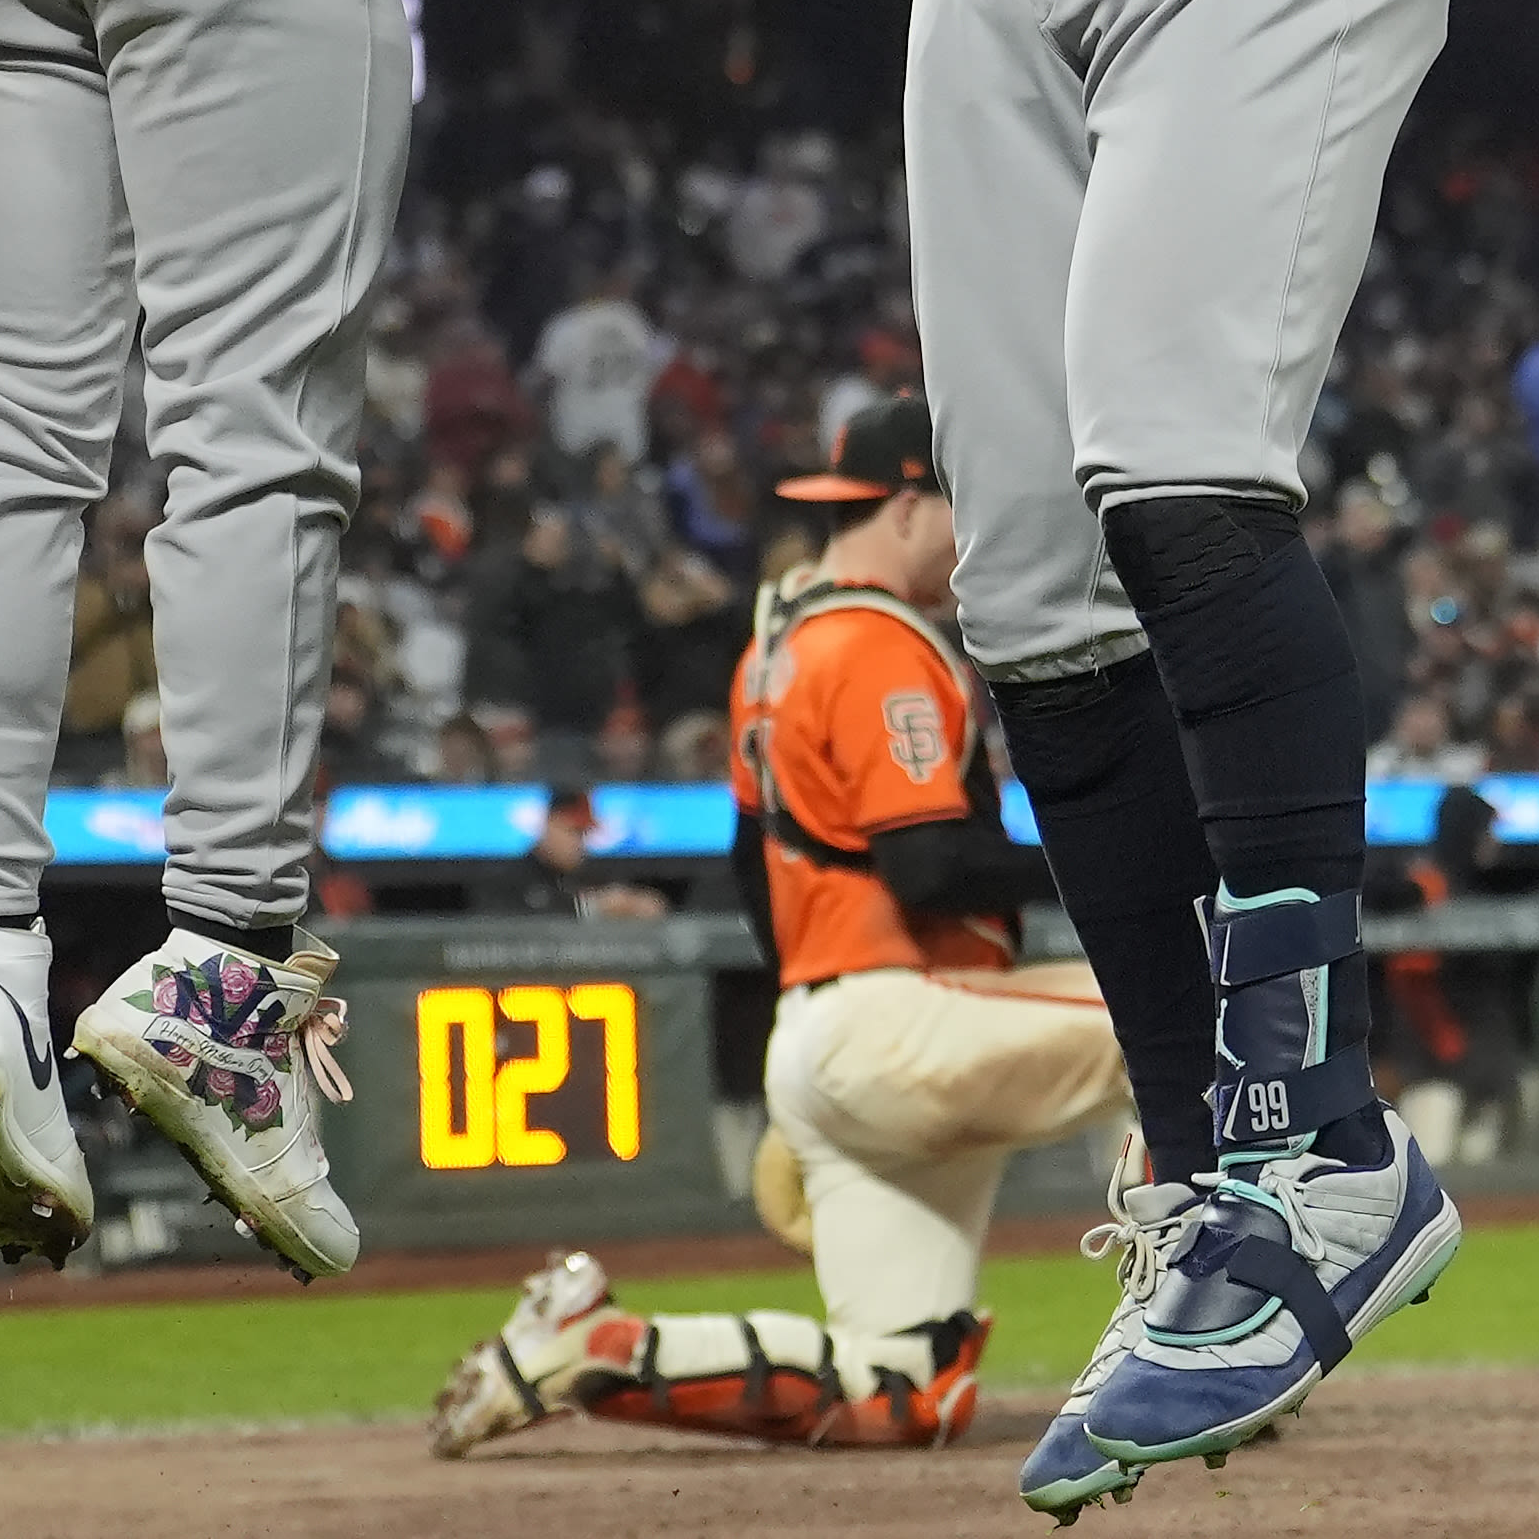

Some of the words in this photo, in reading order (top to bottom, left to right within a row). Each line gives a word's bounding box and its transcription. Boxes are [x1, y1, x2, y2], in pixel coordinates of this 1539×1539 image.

[882, 693, 946, 784] SF
[418, 983, 641, 1168] 027
[1247, 1080, 1290, 1132] 99
